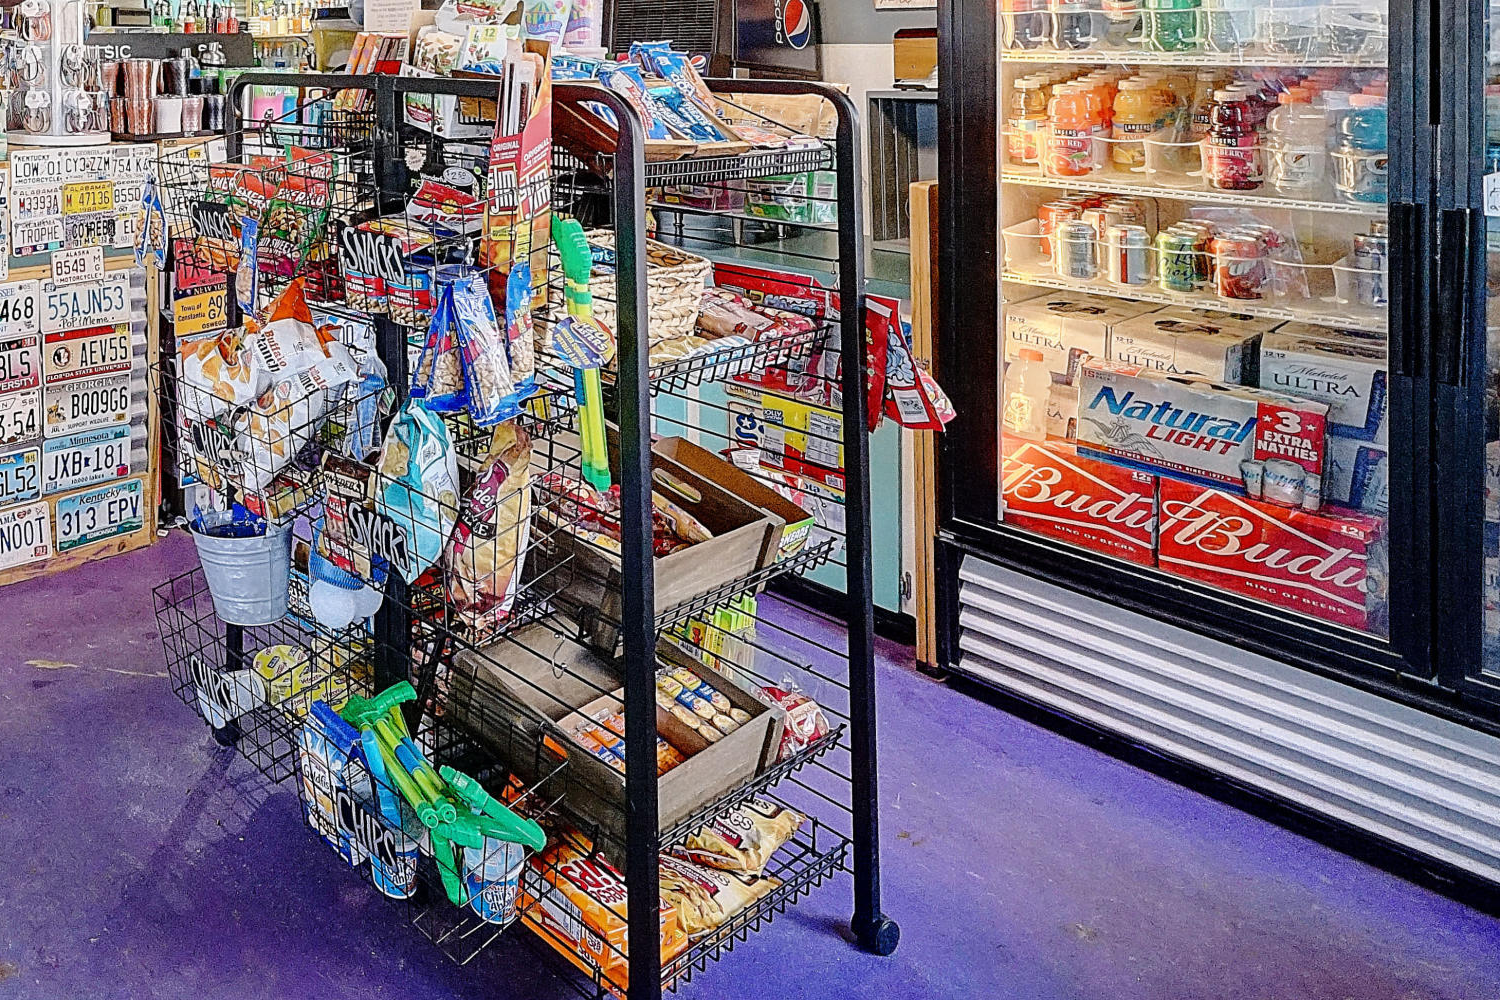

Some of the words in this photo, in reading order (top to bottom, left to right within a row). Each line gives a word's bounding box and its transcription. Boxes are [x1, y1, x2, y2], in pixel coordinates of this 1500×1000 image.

[493, 140, 520, 152] ORIGINAL
[19, 187, 59, 196] ALABAMA
[70, 184, 107, 192] ALABAMA
[66, 250, 90, 258] ALASKA
[343, 227, 406, 284] SNACKS
[0, 296, 34, 322] 468
[178, 312, 206, 322] Constantia
[202, 320, 226, 329] OSWEGO
[1012, 333, 1065, 351] ULTRA
[47, 371, 74, 381] FLORIDA
[75, 369, 93, 377] STATE
[94, 363, 131, 373] UNIVERSITY
[1118, 351, 1178, 374] ULTRA
[1281, 364, 1348, 382] Michelob
[65, 379, 113, 392] GEORGIA
[1272, 372, 1361, 398] ULTRA
[1089, 385, 1258, 443] Natural
[1274, 411, 1302, 434] 3
[69, 433, 109, 446] Minnesota
[1146, 425, 1242, 455] LIGHT
[1263, 430, 1312, 450] EXTRA
[1257, 440, 1318, 462] NATTIES
[79, 487, 121, 505] Kentucky
[62, 507, 97, 536] 313
[108, 495, 140, 525] EPV
[350, 503, 410, 572] SNACKS
[1245, 581, 1277, 595] KING
[1302, 597, 1346, 614] BEERS
[337, 791, 398, 872] CHIPS
